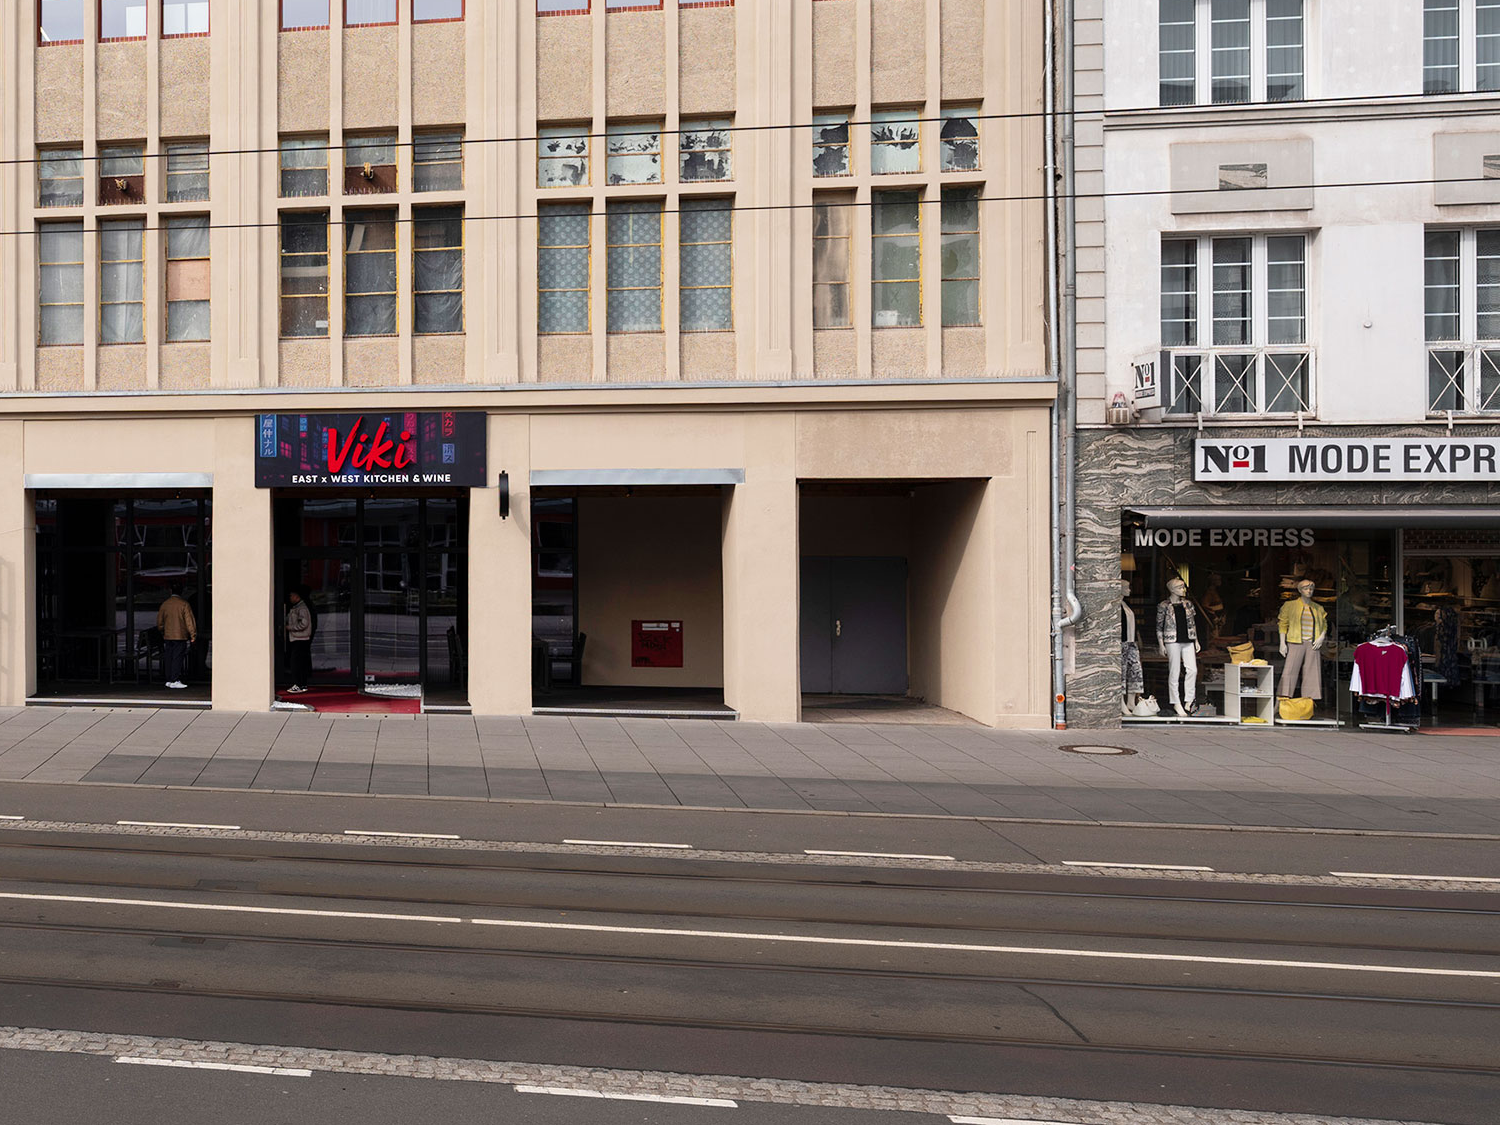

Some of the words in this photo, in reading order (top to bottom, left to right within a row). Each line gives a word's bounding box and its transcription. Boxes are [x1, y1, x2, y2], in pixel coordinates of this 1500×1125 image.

[327, 415, 413, 473] Viki
[1288, 444, 1391, 473] MODE
[1403, 444, 1497, 473] EXPR
[292, 475, 318, 483] EAST
[331, 475, 360, 483] WEST
[363, 474, 409, 483] KITCHEN
[412, 474, 420, 483] &
[423, 474, 451, 483] WINE
[1135, 529, 1202, 547] MODE
[1209, 529, 1315, 547] EXPRESS
